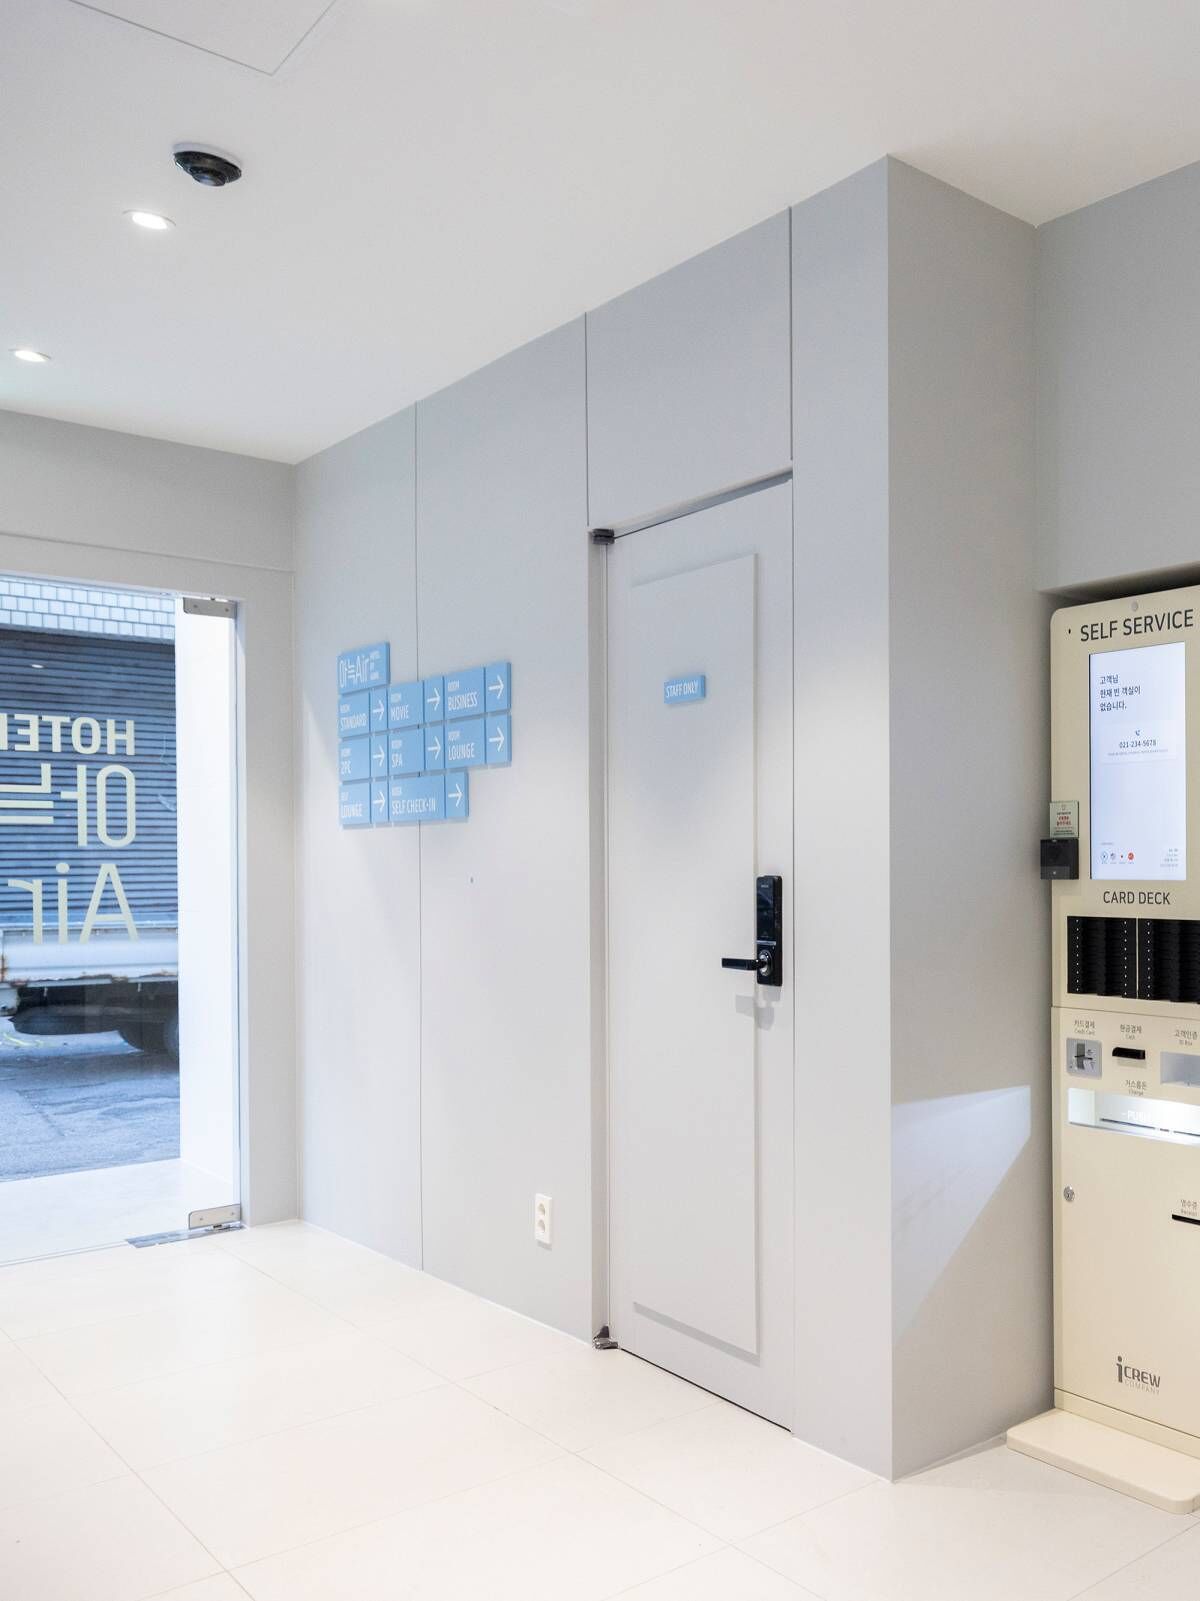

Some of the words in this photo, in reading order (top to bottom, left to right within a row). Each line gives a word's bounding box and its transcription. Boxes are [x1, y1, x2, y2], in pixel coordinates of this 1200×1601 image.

[1080, 620, 1118, 642] SELF
[1122, 608, 1194, 636] SERVICE
[1100, 674, 1119, 685] 고객님
[666, 683, 683, 698] STAFF
[1122, 685, 1141, 696] 객실이
[447, 691, 478, 712] BUSINESS
[390, 704, 409, 721] MOVIE
[447, 742, 475, 761] LOUNGE
[391, 753, 403, 768] SPA
[1103, 890, 1135, 904] CARD
[1138, 891, 1171, 905] DECK
